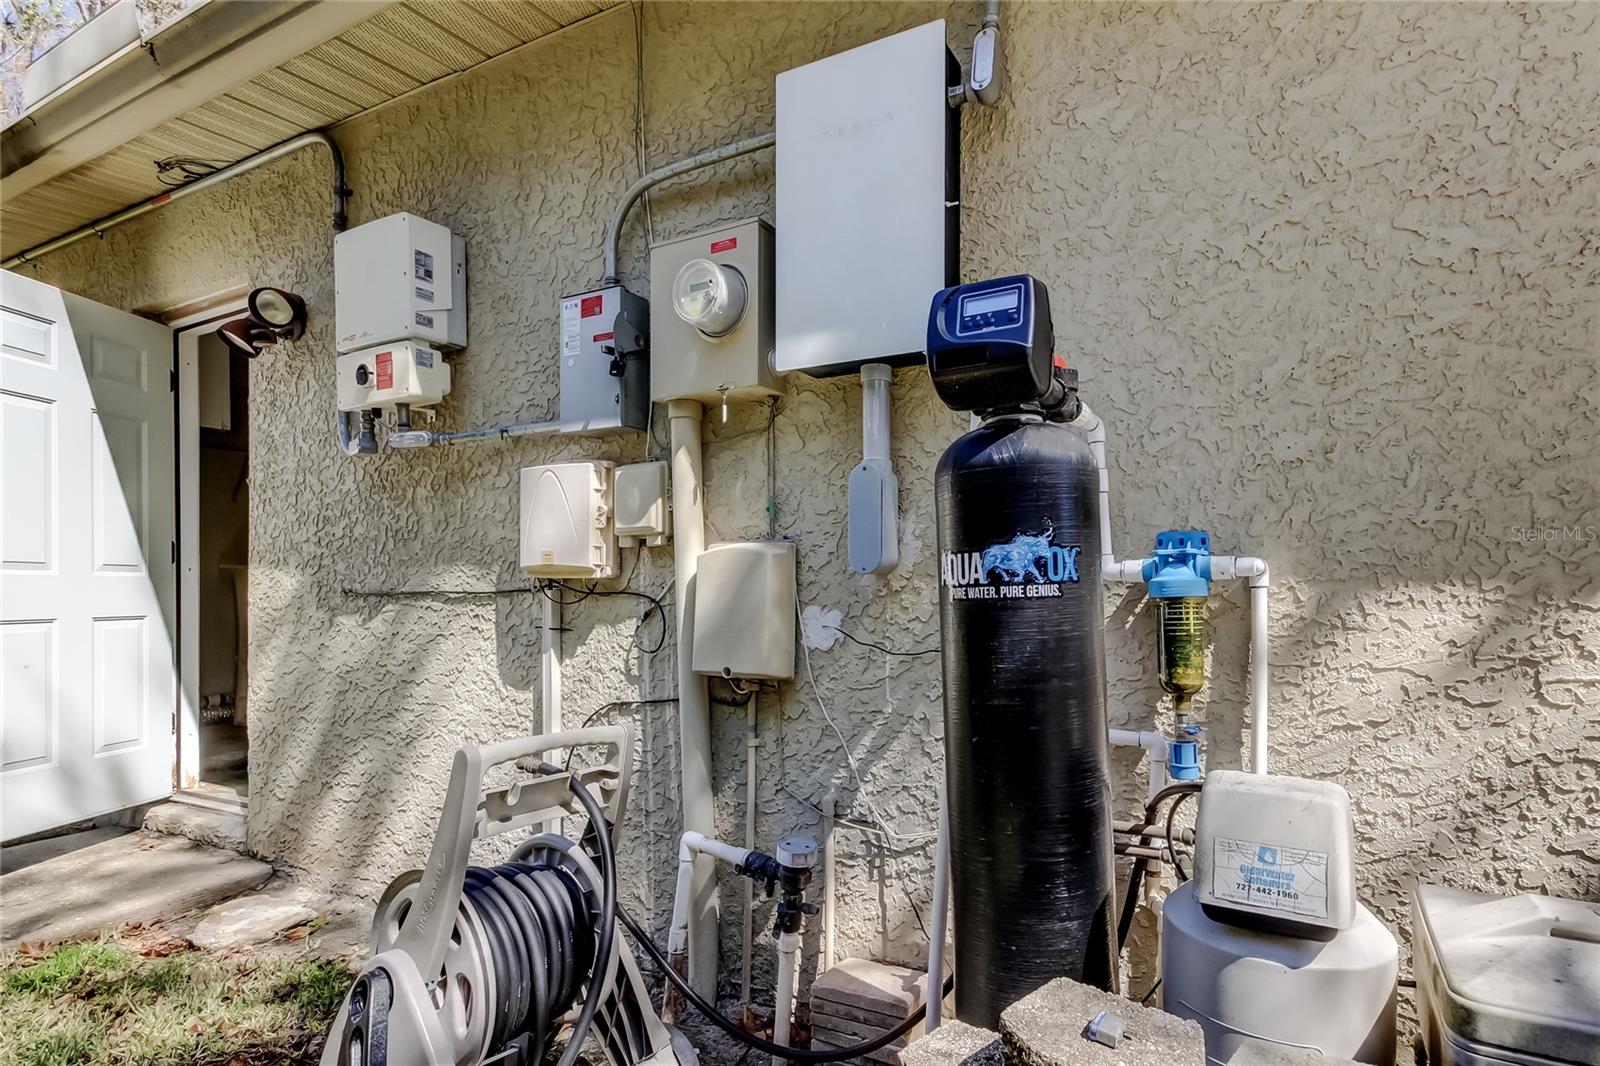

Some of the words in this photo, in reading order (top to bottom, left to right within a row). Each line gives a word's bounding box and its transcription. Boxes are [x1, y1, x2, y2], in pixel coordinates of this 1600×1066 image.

[941, 550, 986, 587] AQUA
[1047, 546, 1080, 583] OX
[967, 586, 998, 599] WATER.
[1000, 585, 1025, 598] PURE
[1026, 583, 1062, 597] GENIUS.
[1236, 882, 1299, 900] 727-442-1960
